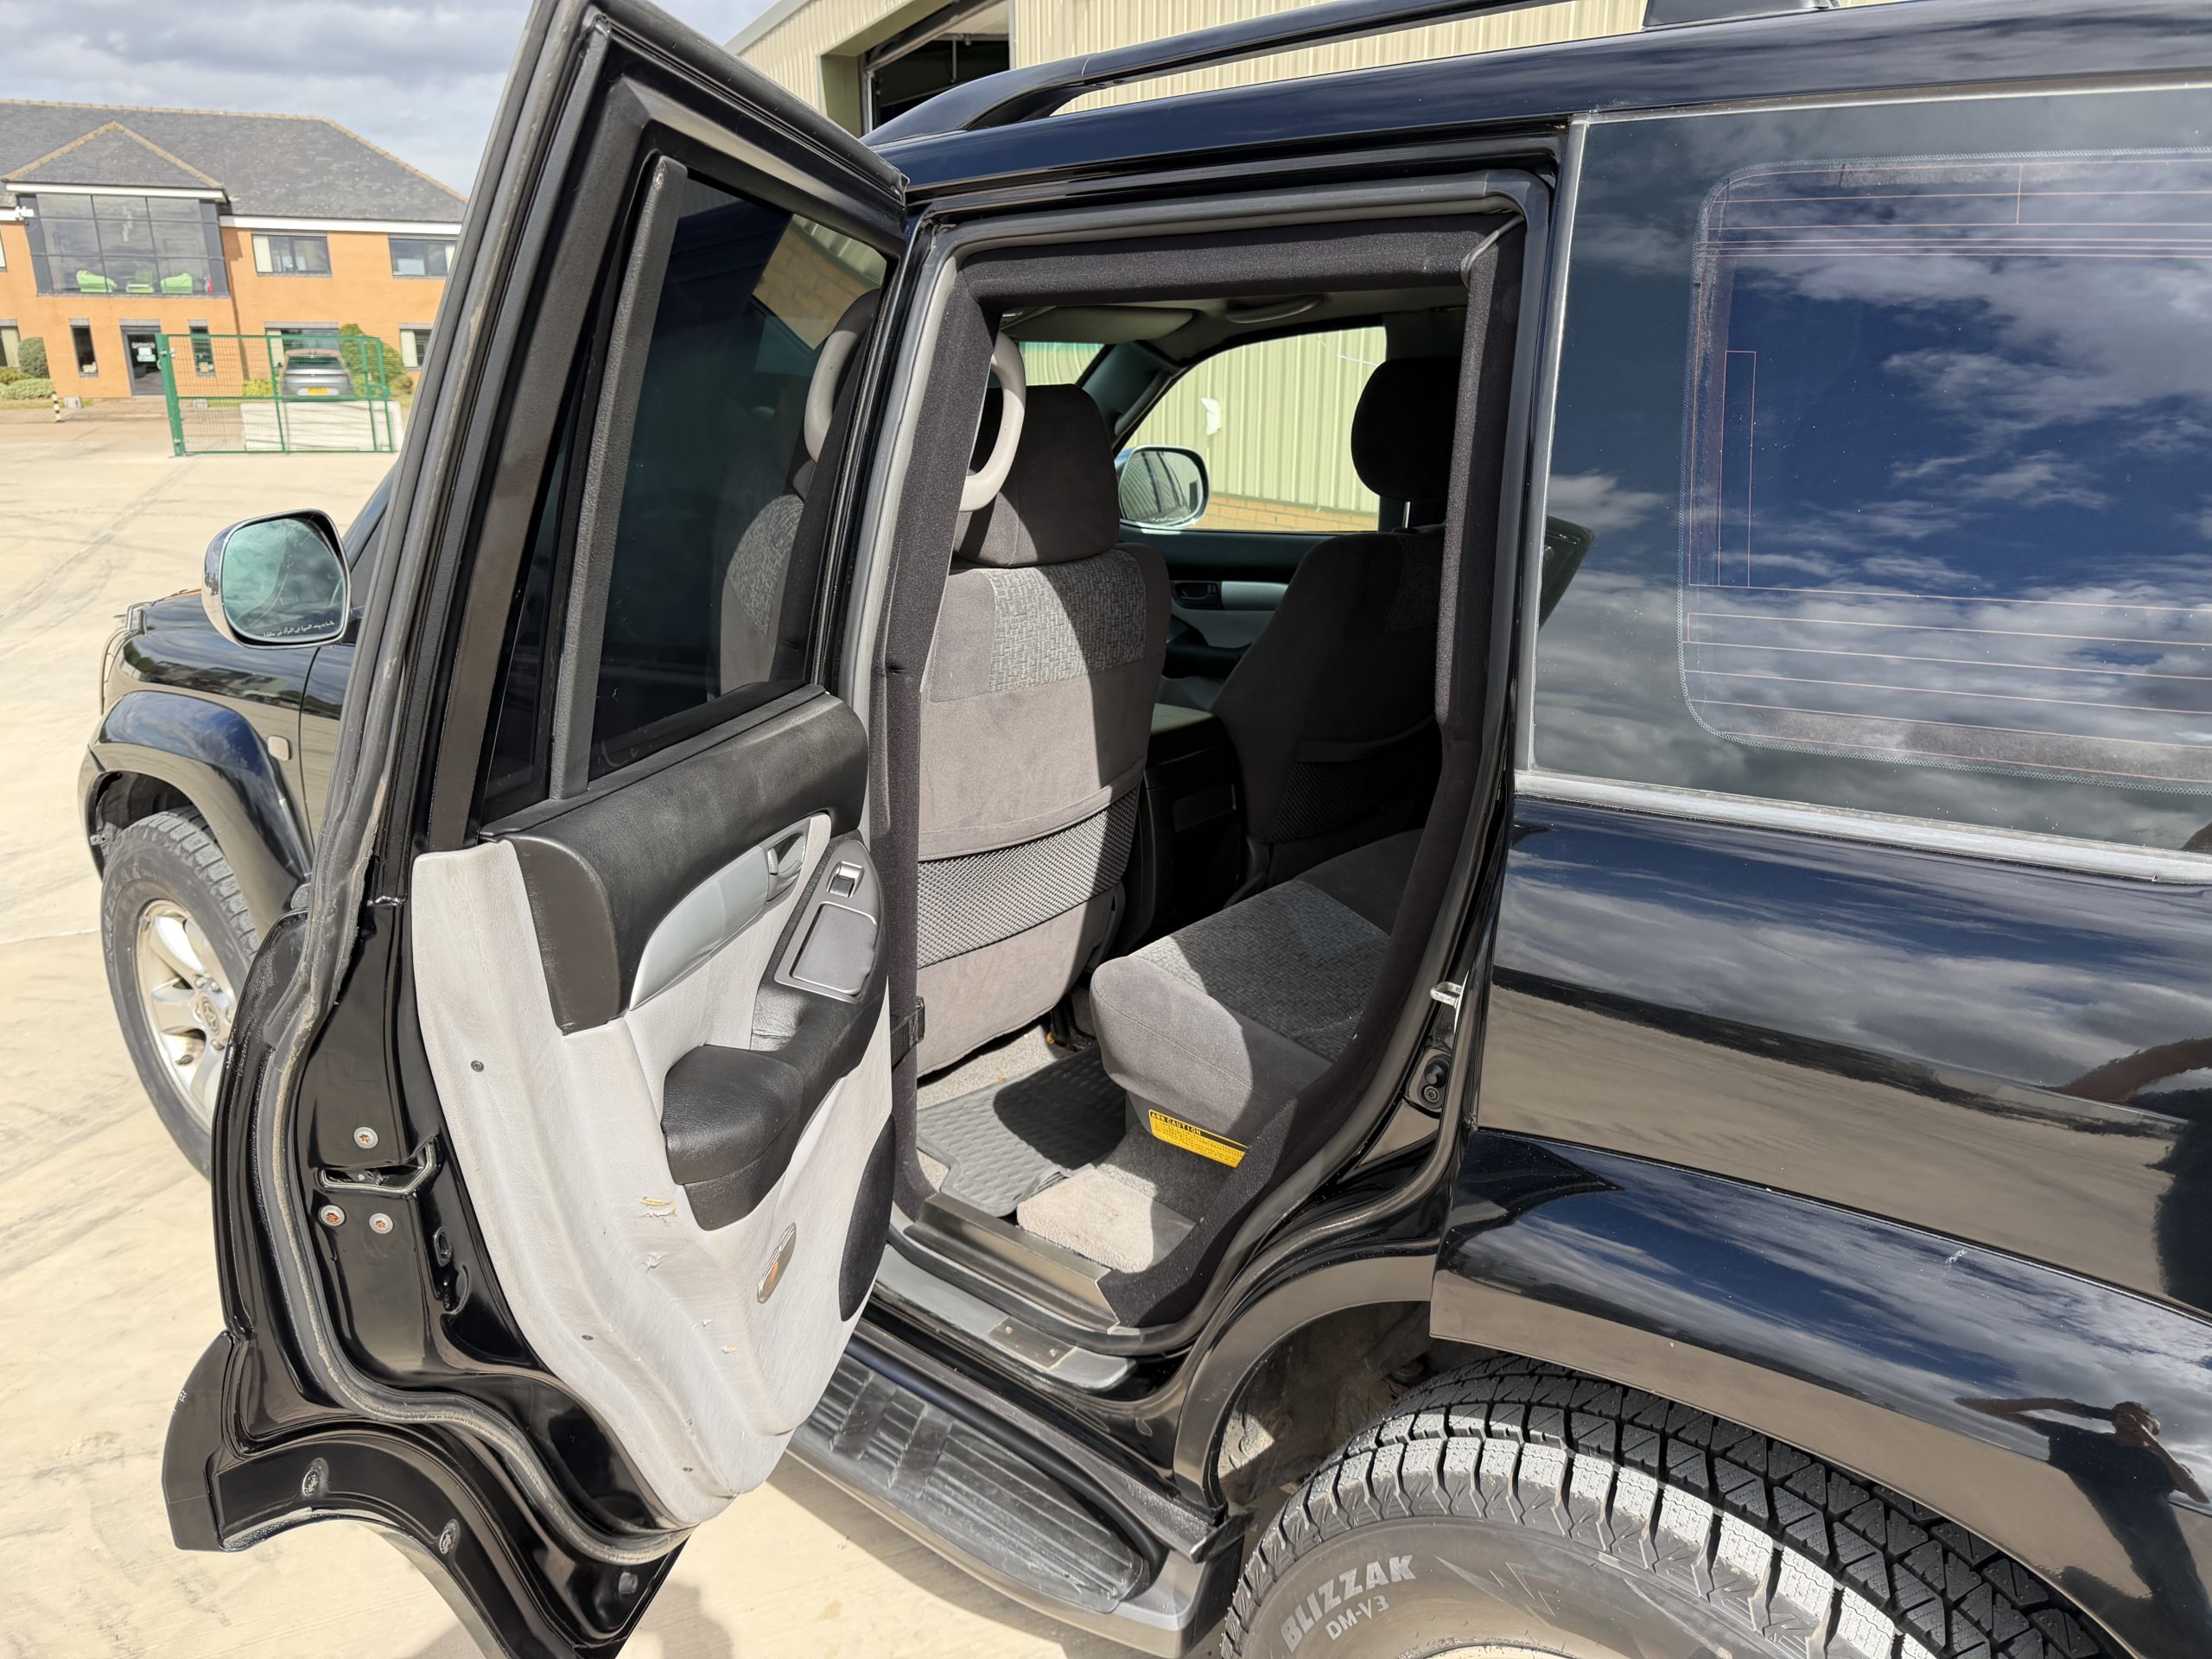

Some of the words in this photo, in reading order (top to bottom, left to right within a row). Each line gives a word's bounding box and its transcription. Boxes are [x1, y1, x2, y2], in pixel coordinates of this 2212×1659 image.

[1166, 1118, 1202, 1136] CAUTION
[1281, 1554, 1416, 1652] BLIZZAK
[1325, 1594, 1389, 1640] DM-V3
